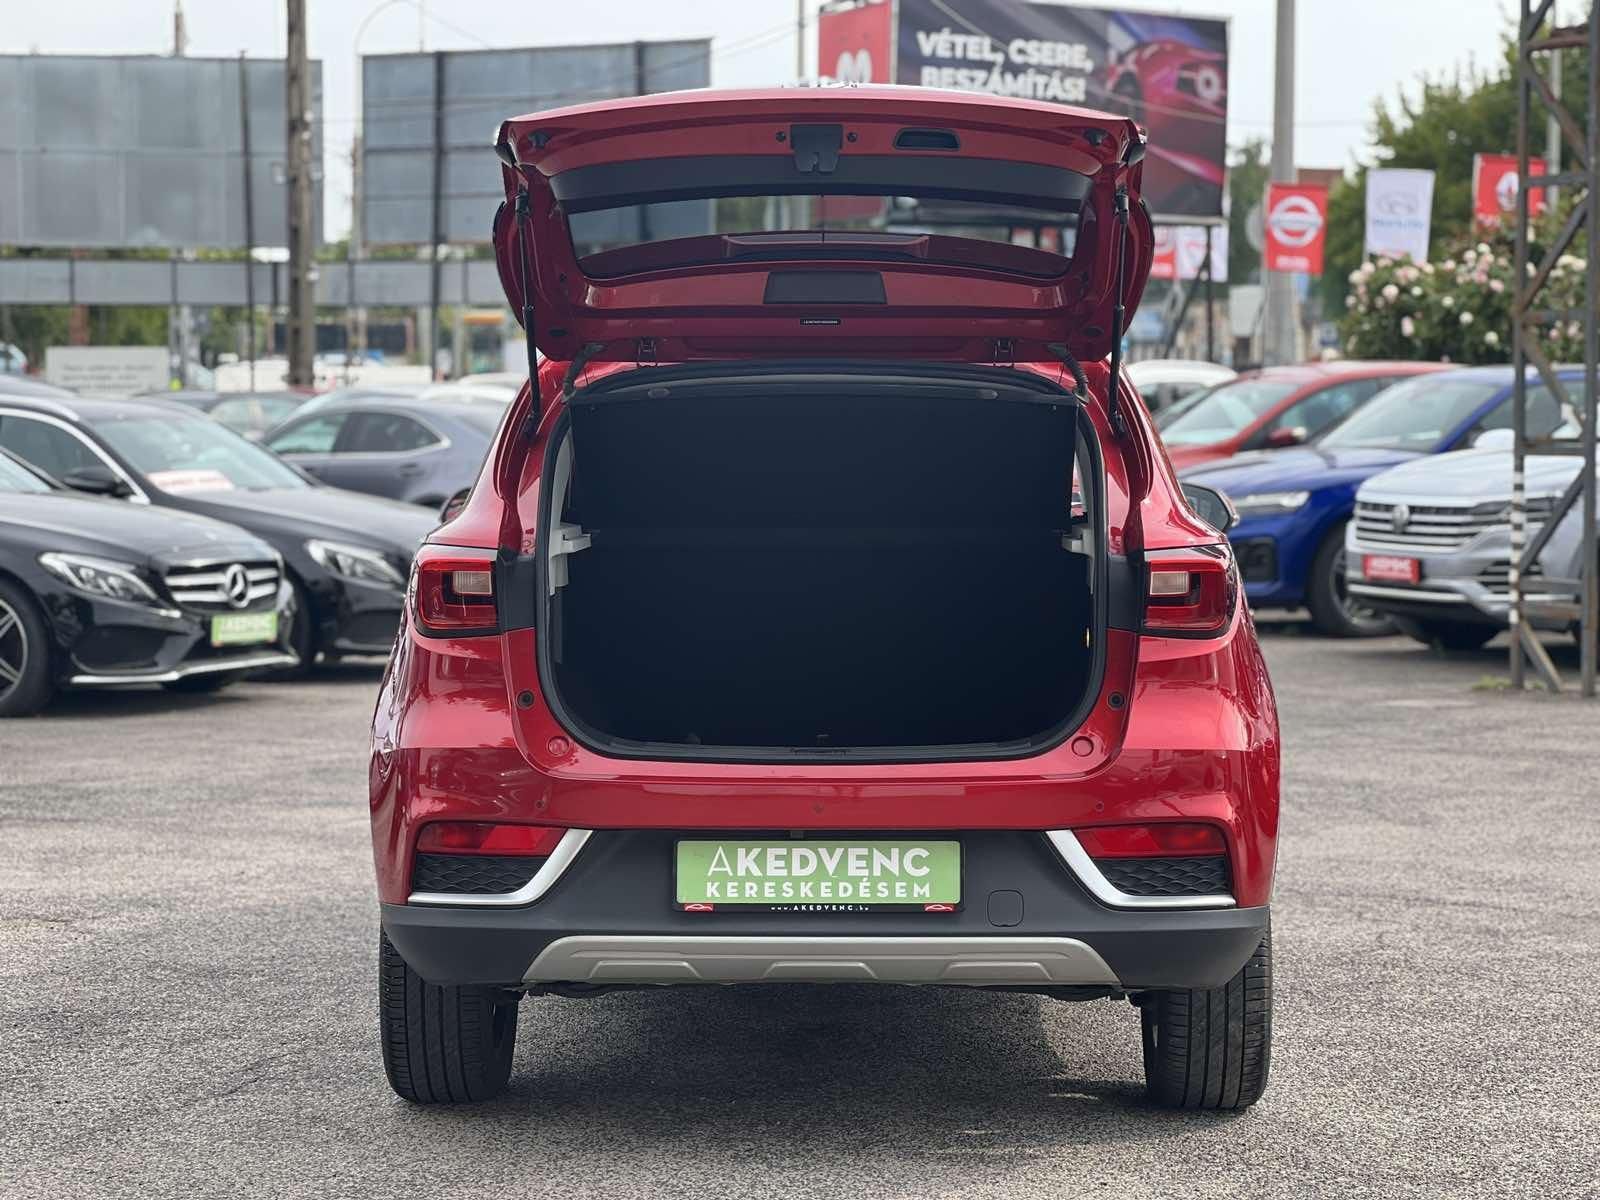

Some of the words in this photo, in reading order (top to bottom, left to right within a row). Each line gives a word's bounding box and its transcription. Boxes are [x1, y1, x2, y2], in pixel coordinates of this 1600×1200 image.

[916, 27, 1005, 66] VÉTEL,
[1008, 38, 1095, 74] CSERE,
[707, 845, 931, 877] AKEDVENC
[706, 878, 931, 898] KERESKEDÉSEM
